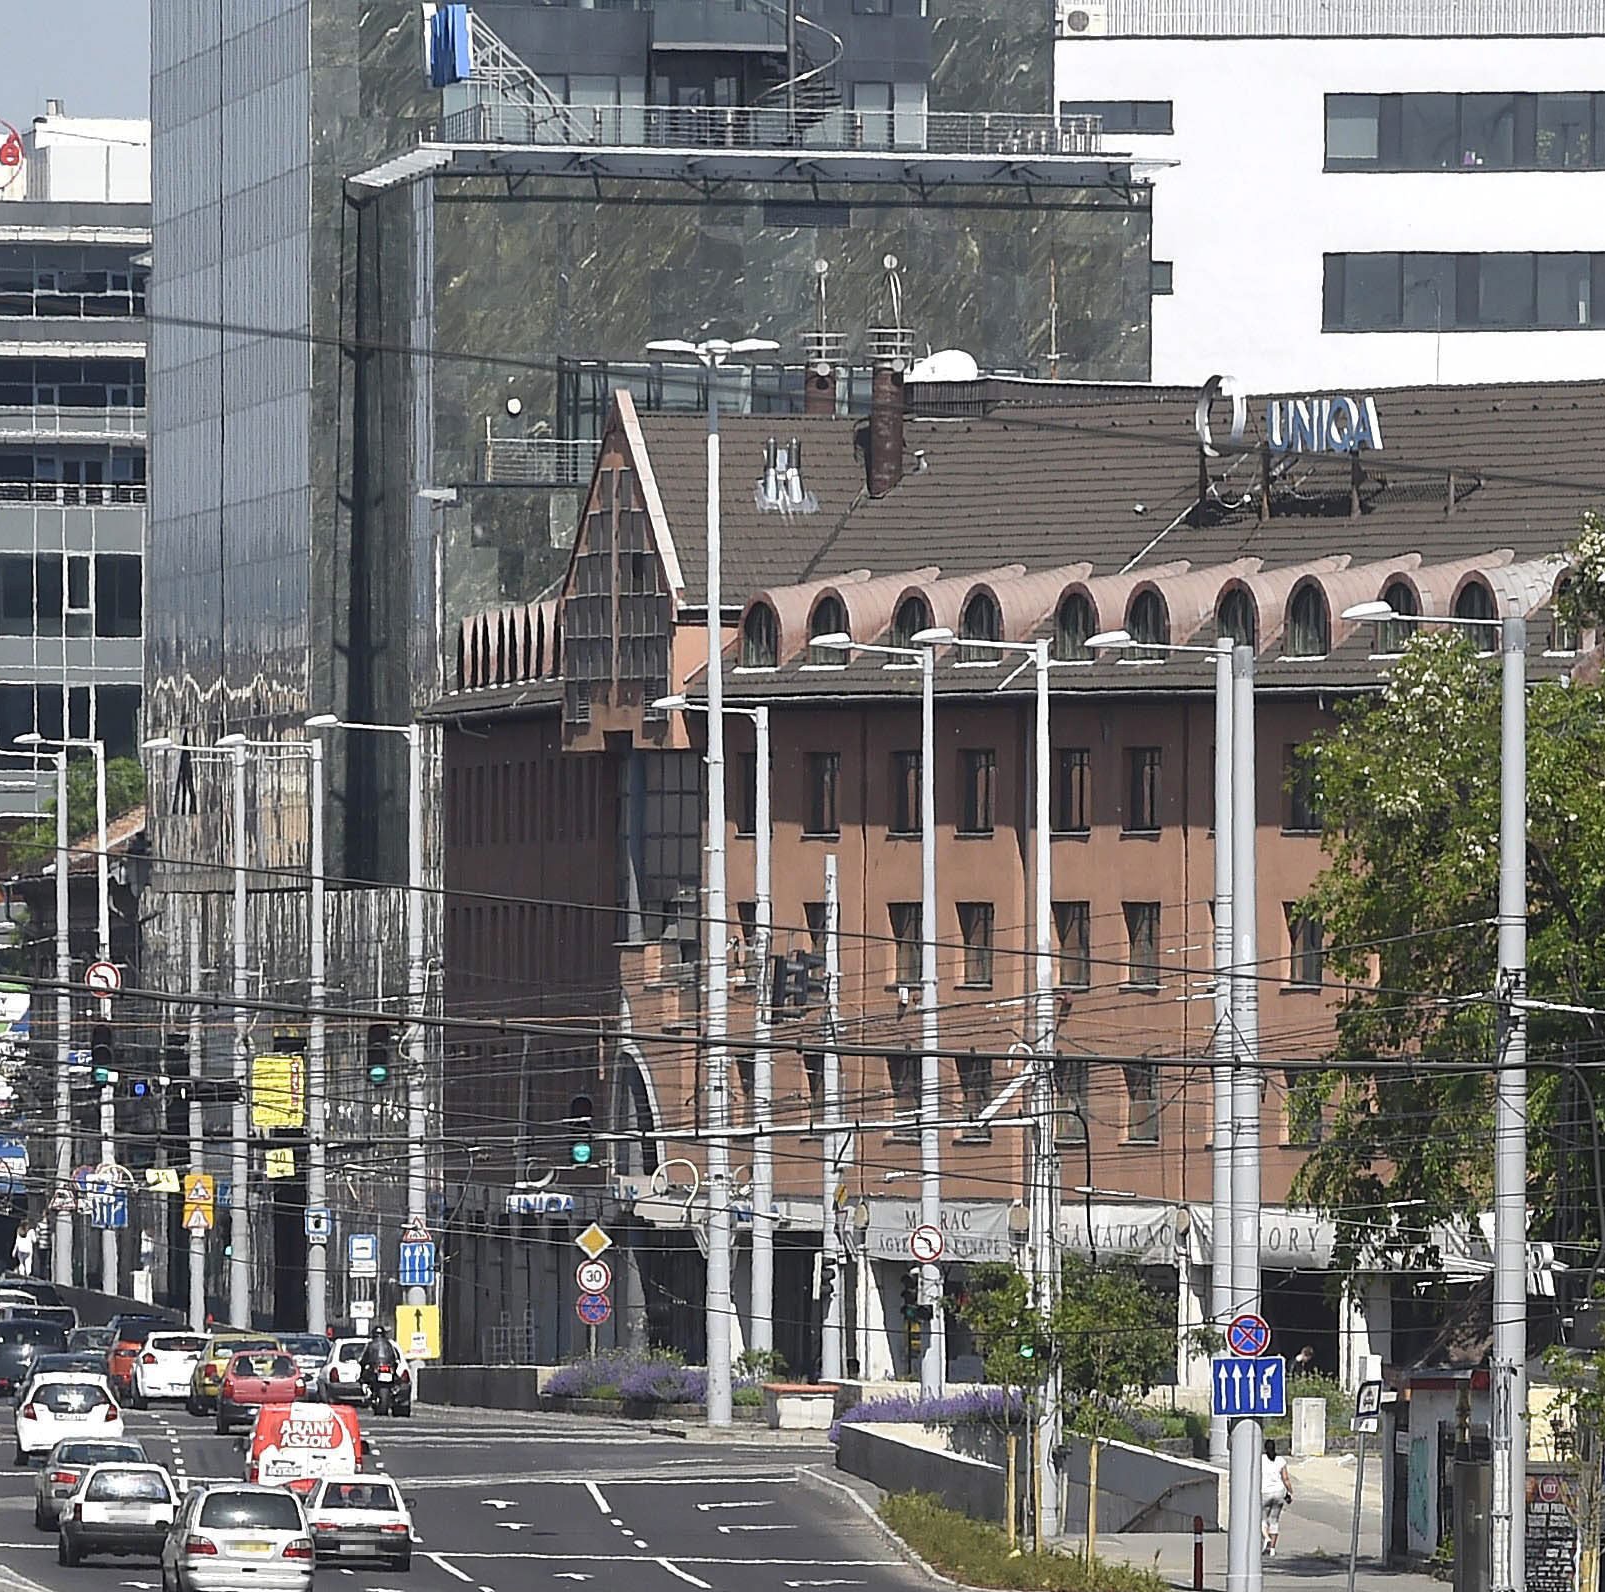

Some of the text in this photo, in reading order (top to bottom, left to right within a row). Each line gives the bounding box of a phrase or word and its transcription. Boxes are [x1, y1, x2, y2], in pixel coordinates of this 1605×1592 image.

[1266, 396, 1384, 452] UNIQA
[905, 1210, 972, 1231] MRAC
[585, 1269, 602, 1283] 30
[279, 1420, 335, 1434] ARANY
